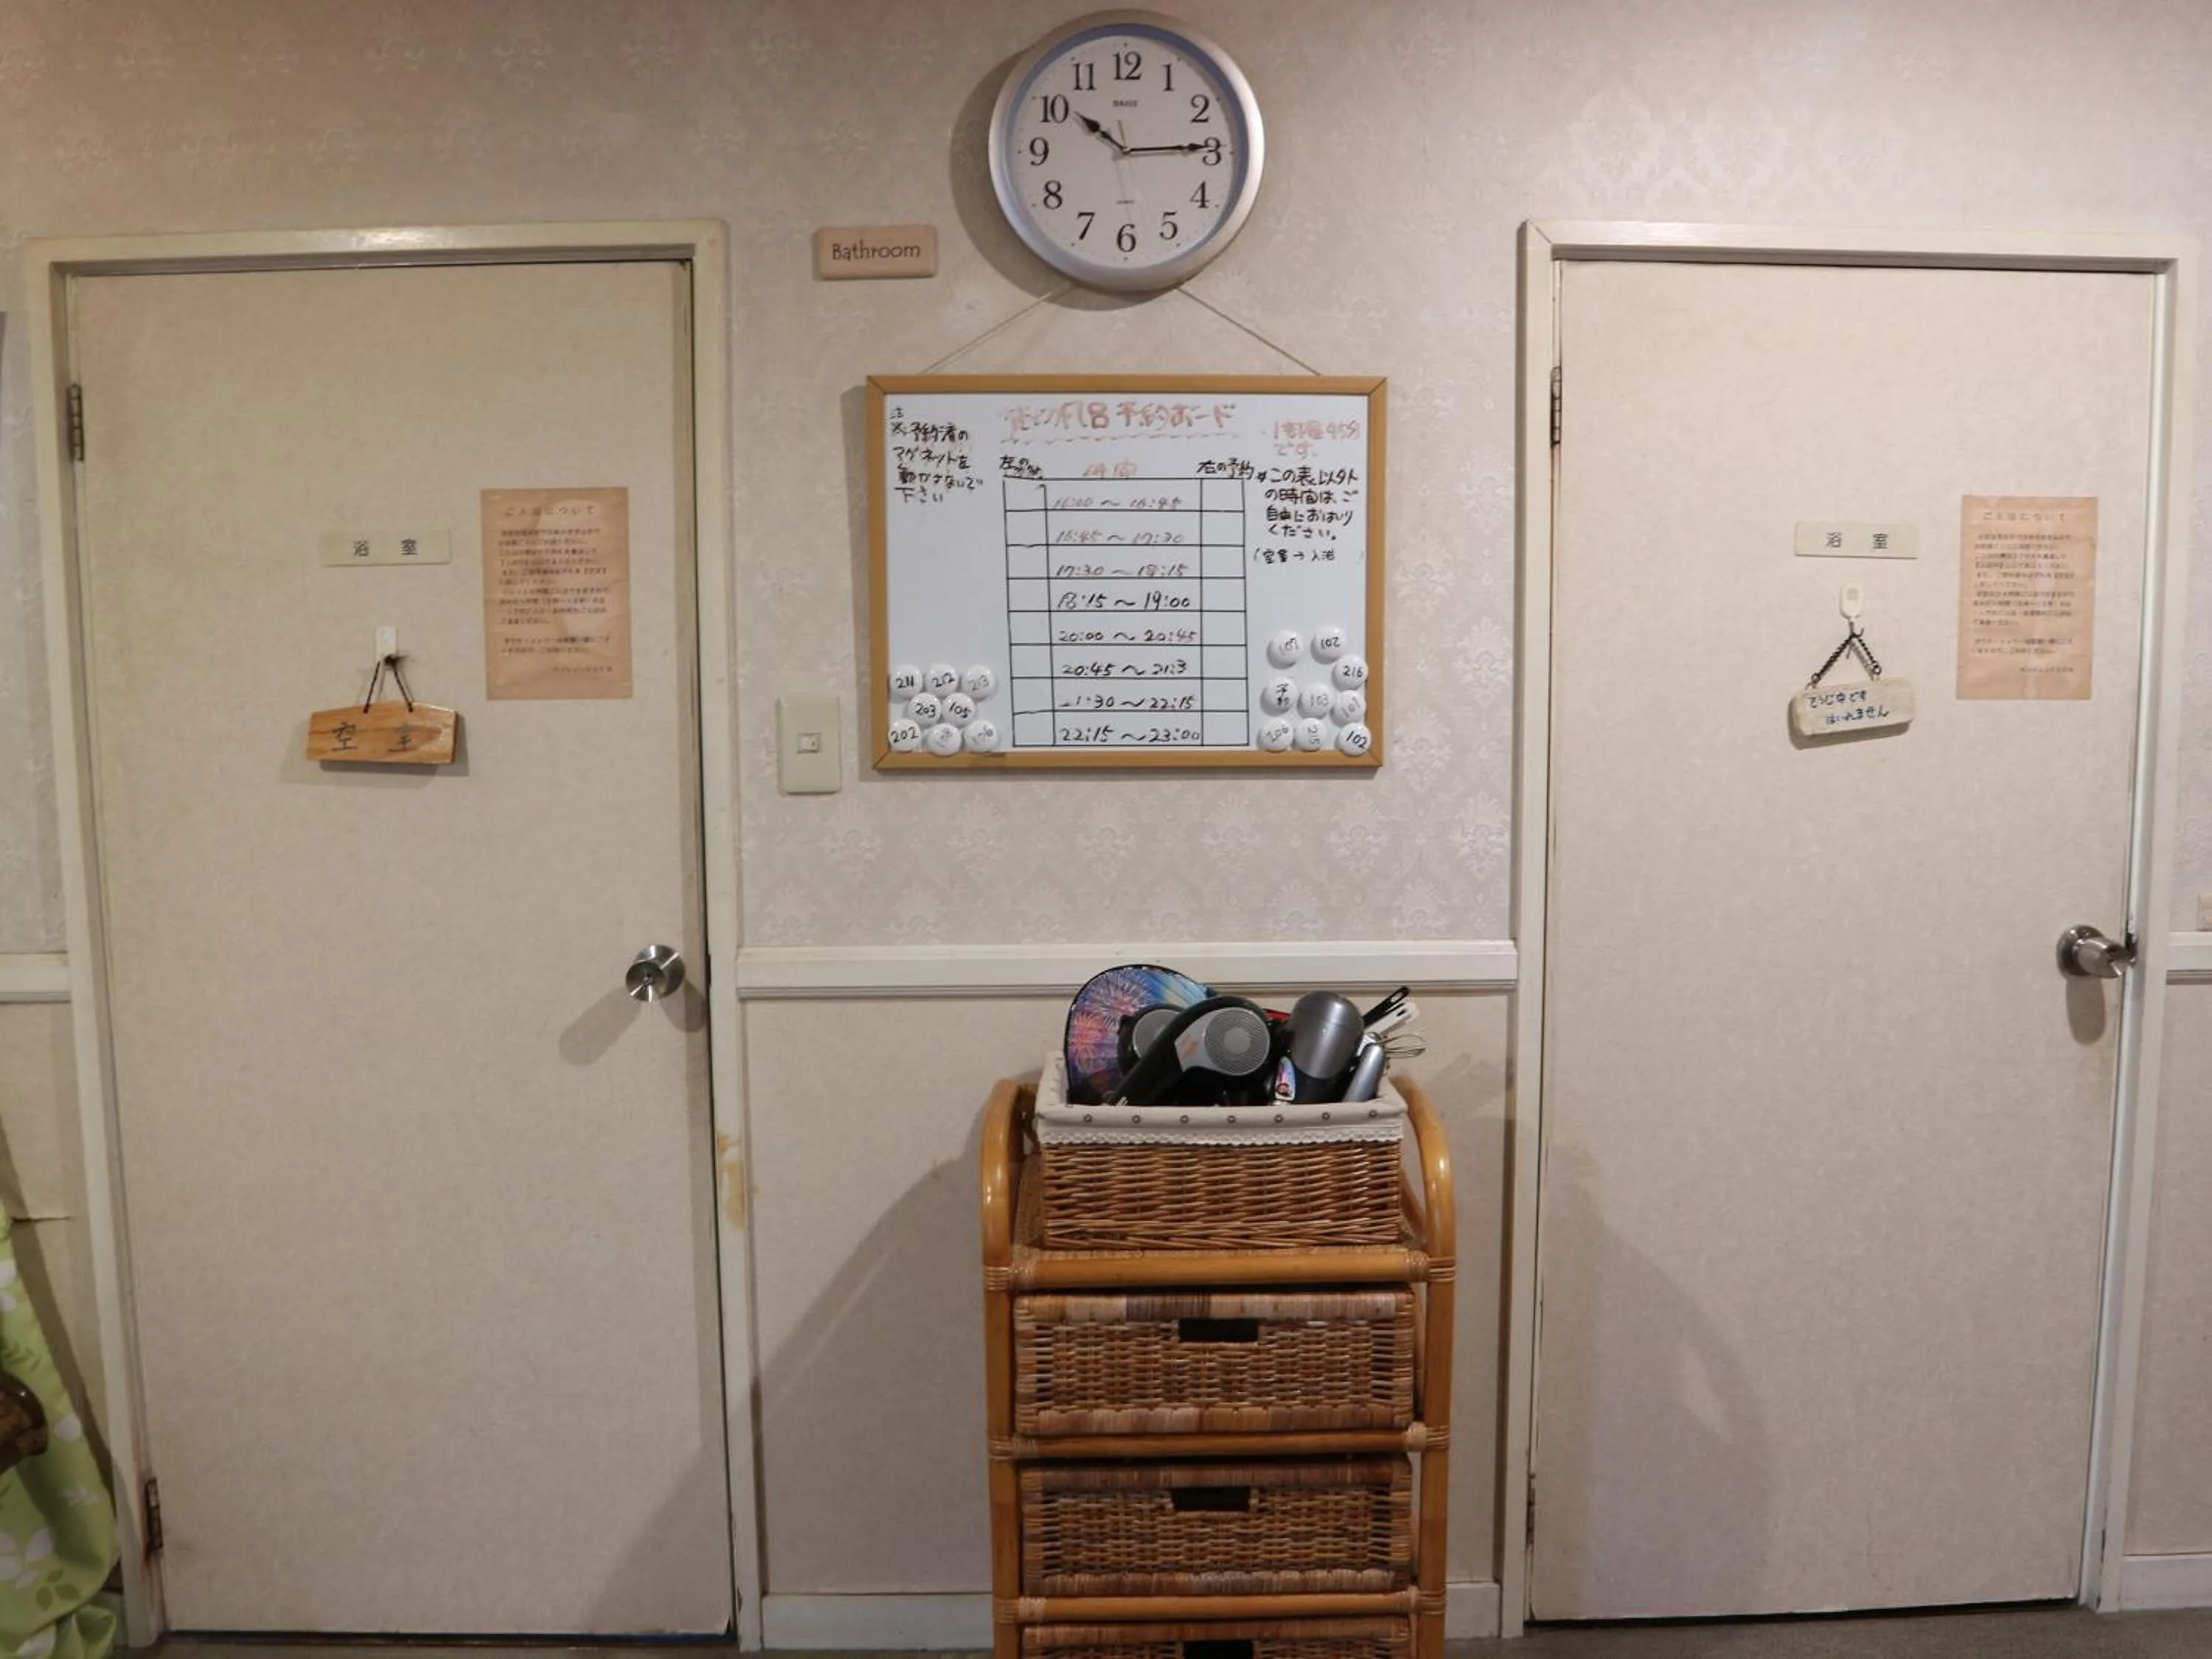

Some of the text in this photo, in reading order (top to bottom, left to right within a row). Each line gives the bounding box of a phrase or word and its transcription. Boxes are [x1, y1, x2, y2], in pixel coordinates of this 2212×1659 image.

[1073, 63, 1097, 91] 11
[1113, 51, 1142, 80] 12
[1162, 63, 1175, 91] 1
[1041, 94, 1069, 123] 10
[1190, 94, 1210, 123] 2
[1029, 137, 1050, 166] 9
[1202, 137, 1222, 166] 3
[1043, 180, 1063, 209] 8
[1189, 181, 1210, 209] 4
[1077, 212, 1095, 240] 7
[1116, 223, 1136, 252] 6
[1159, 212, 1178, 240] 5
[832, 238, 920, 262] Bathroom
[1144, 589, 1191, 611] 19:00
[1060, 726, 1114, 742] 22:15
